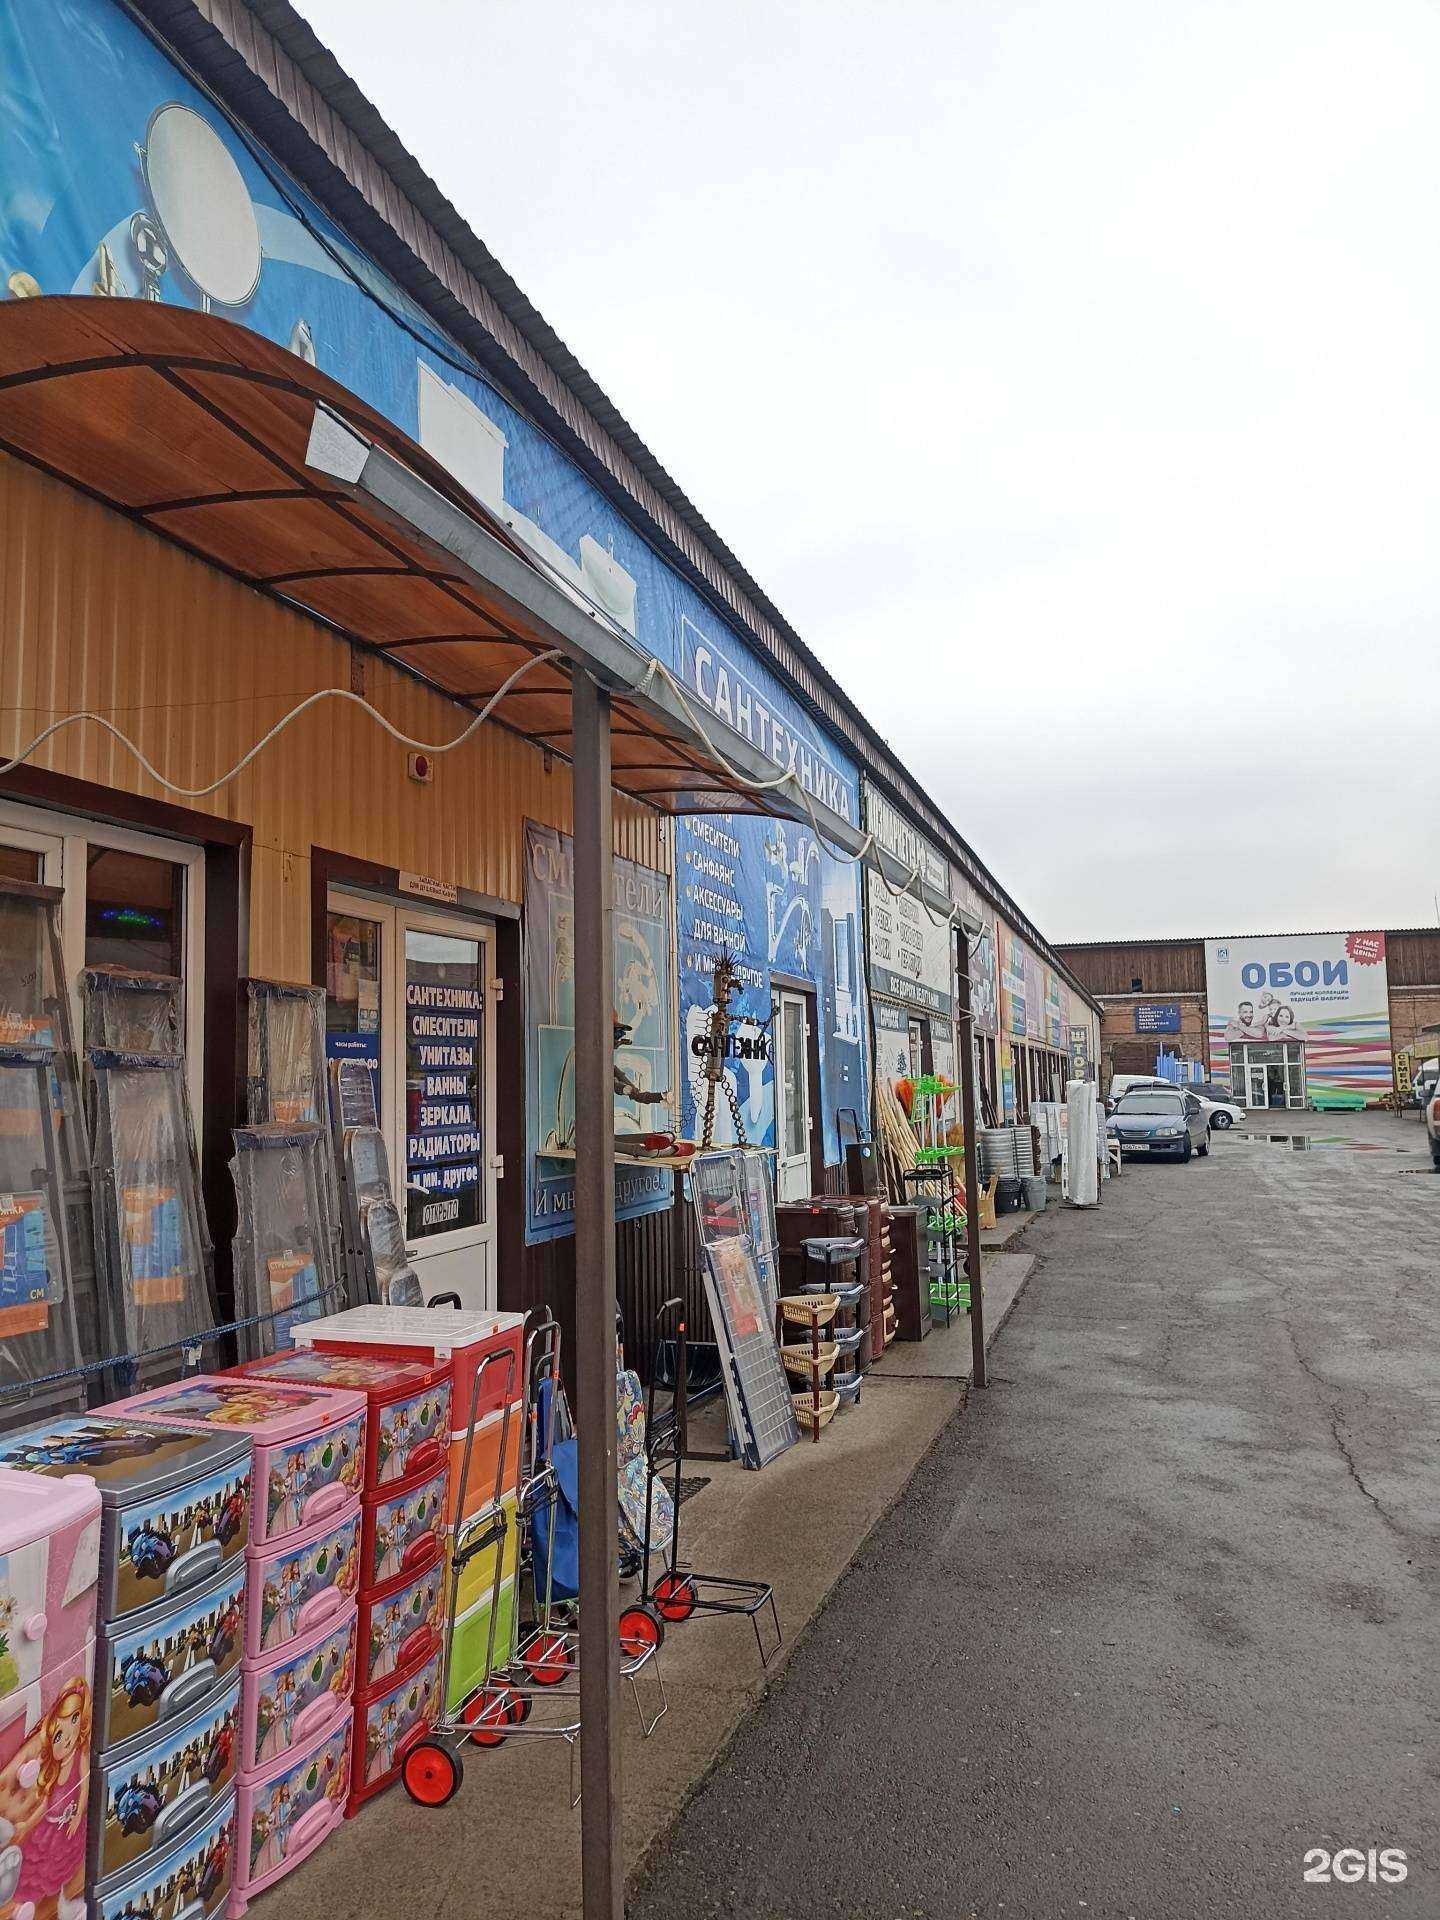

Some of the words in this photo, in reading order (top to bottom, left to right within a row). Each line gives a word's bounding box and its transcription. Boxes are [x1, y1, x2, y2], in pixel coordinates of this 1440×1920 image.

[695, 646, 849, 821] САНТЕХНИКА
[692, 816, 740, 858] СМЕСИТЕЛИ
[693, 851, 735, 888] САНФАЯНС
[693, 886, 744, 921] АКСЕССУАРЫ
[693, 919, 713, 943] ДЛЯ
[712, 926, 747, 952] ВАННОЙ
[1363, 939, 1380, 948] НАС
[1241, 959, 1348, 989] ОБОИ
[407, 985, 483, 1010] САНТЕХНИКА:
[412, 1015, 478, 1038] СМЕСИТЕЛИ
[419, 1045, 473, 1066] УНИТАЗЫ
[427, 1076, 467, 1096] ВАННЫ
[1398, 1054, 1408, 1090] СЕМЕНА
[420, 1105, 471, 1127] ЗЕРКАЛА
[410, 1132, 480, 1160] РАДИАТОРЫ
[443, 1166, 478, 1189] другое
[424, 1200, 458, 1224] ОТКРЫТО
[534, 1188, 548, 1216] И
